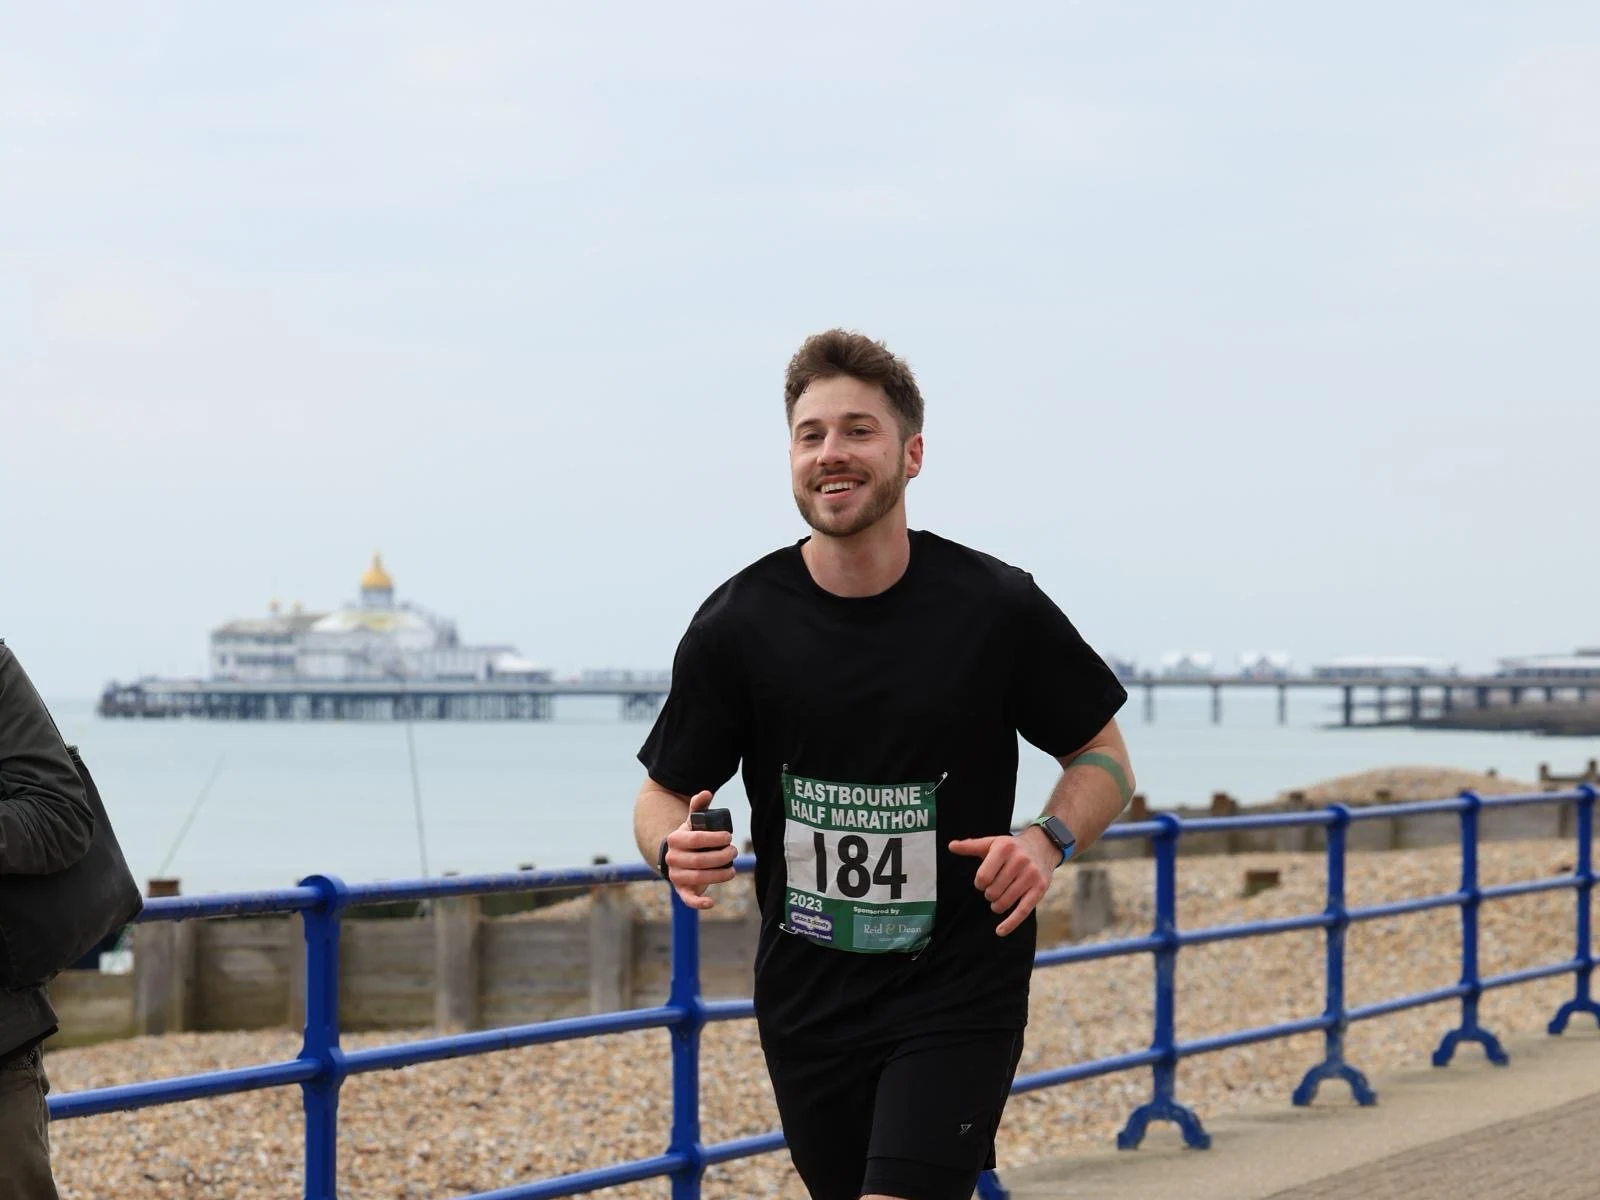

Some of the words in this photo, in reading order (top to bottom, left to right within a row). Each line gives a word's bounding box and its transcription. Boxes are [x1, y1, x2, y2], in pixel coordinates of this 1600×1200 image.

[793, 778, 921, 807] EASTBOURNE
[791, 799, 826, 824] HALF
[831, 808, 928, 830] MARATHON
[813, 831, 908, 900] 184
[788, 892, 823, 913] 2023
[853, 906, 889, 915] Sponsored
[890, 907, 900, 916] by
[863, 923, 882, 934] Reid
[885, 923, 896, 935] &
[898, 924, 922, 934] Dean
